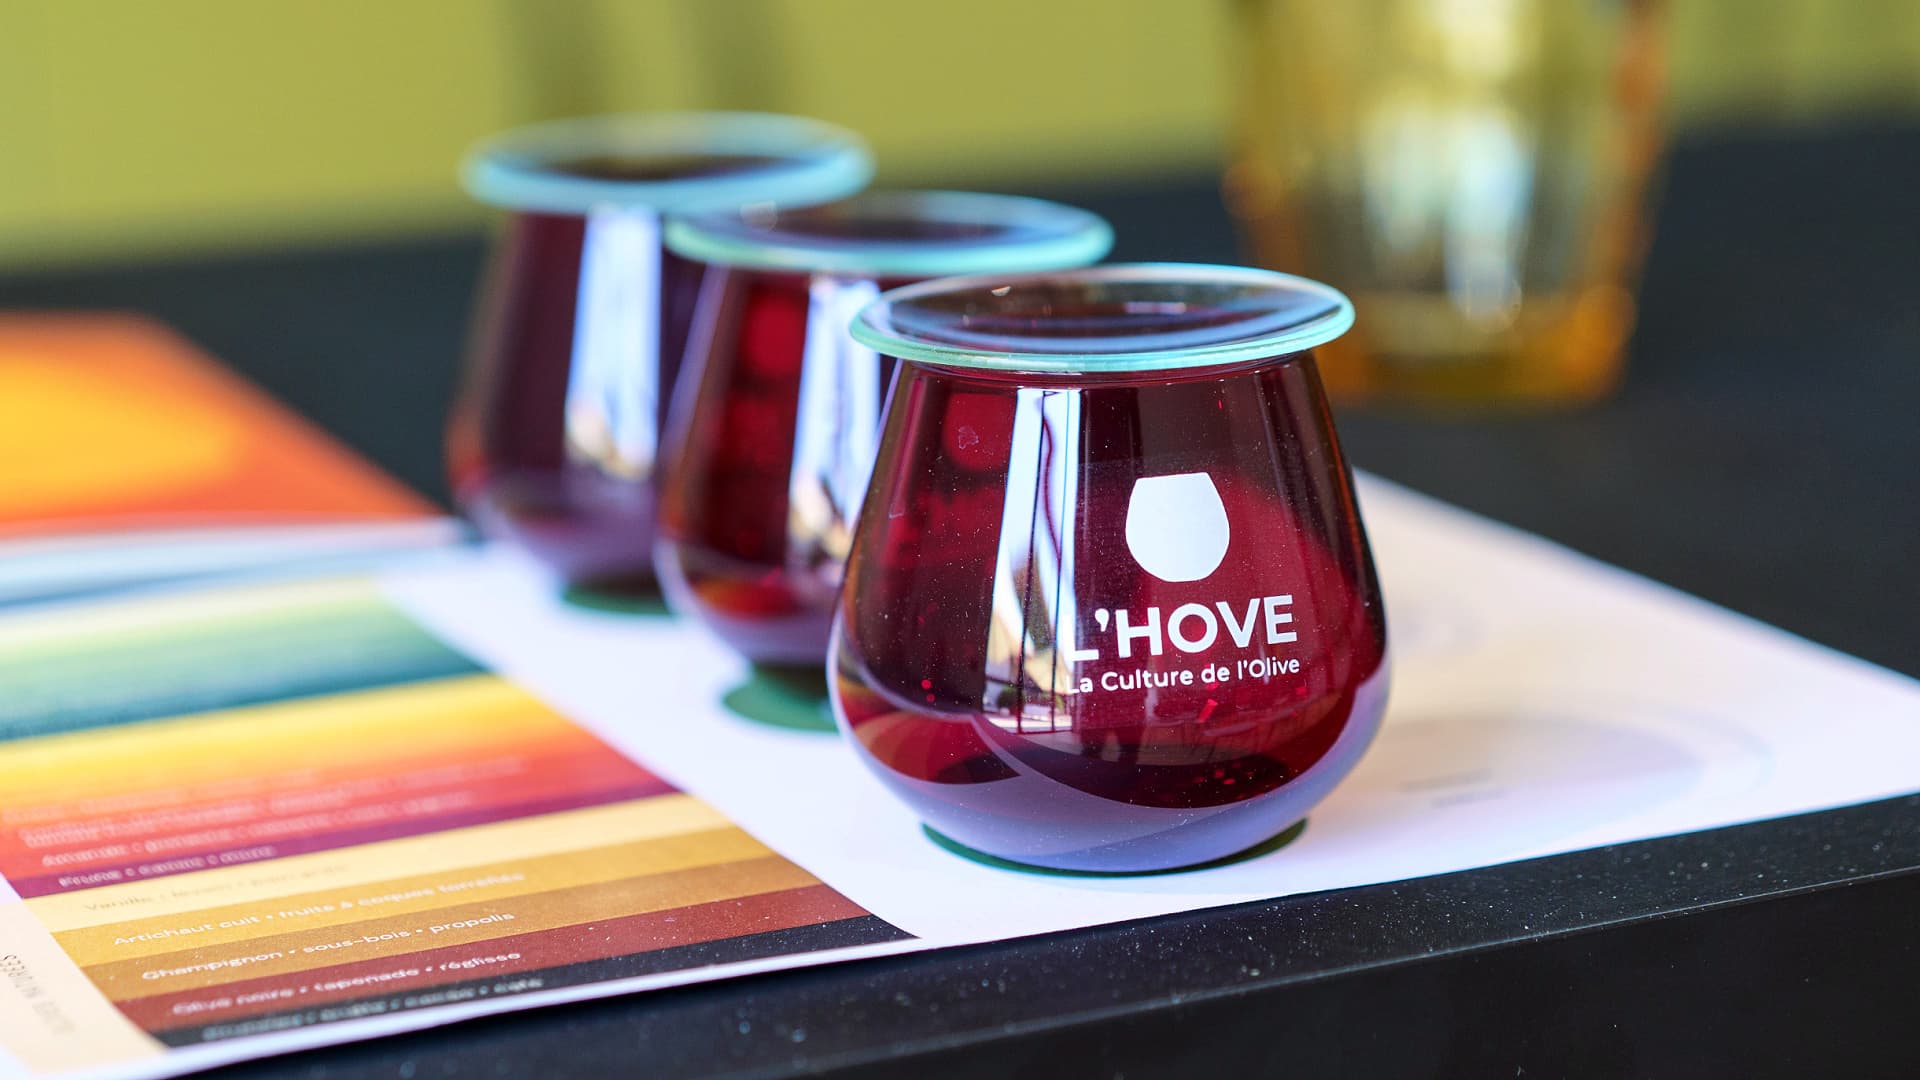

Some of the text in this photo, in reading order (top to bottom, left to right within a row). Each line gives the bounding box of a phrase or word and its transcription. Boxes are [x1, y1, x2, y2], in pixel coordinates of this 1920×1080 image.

[1066, 595, 1297, 662] L'HOVE
[1066, 656, 1300, 694] La Culture de l'Olive
[113, 923, 214, 946] Artichaut
[219, 915, 261, 930] cuit
[278, 904, 336, 919] fruits
[142, 912, 516, 980] Champignon sous-bois propolis
[313, 967, 420, 991] tapenade
[440, 951, 522, 973] réglisse
